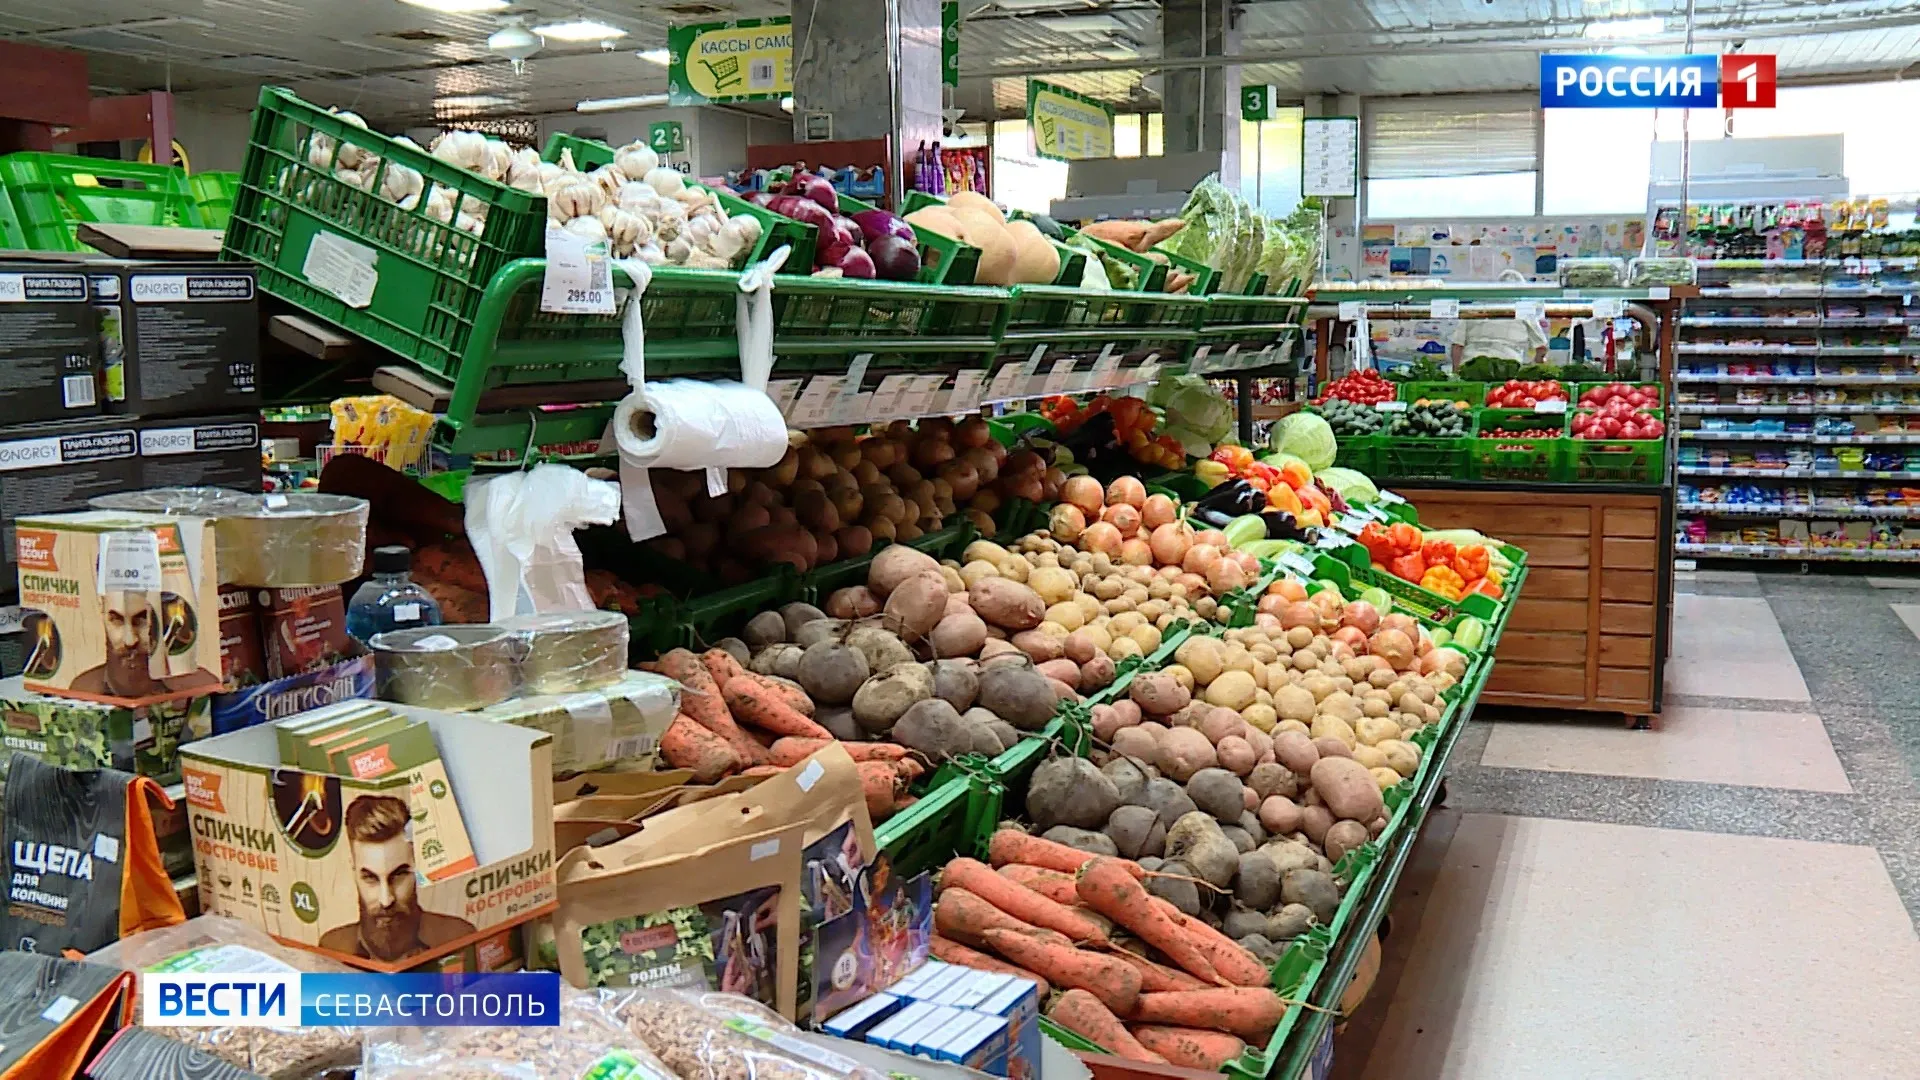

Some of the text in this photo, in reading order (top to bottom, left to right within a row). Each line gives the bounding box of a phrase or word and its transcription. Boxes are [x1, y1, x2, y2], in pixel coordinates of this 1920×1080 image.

[700, 39, 751, 54] КАССЫ
[1247, 91, 1262, 111] 3
[654, 129, 667, 146] 2
[672, 127, 681, 145] 2
[567, 288, 602, 304] 295.00
[23, 574, 80, 596] СПИЧКИ
[193, 813, 277, 854] СПИЧКИ
[14, 841, 93, 880] ЩЕПА
[196, 837, 279, 872] КОСТРОВЫЕ
[465, 849, 552, 899] СПИЧКИ
[294, 891, 316, 912] XL
[465, 873, 553, 916] КОСТРОВЫЕ
